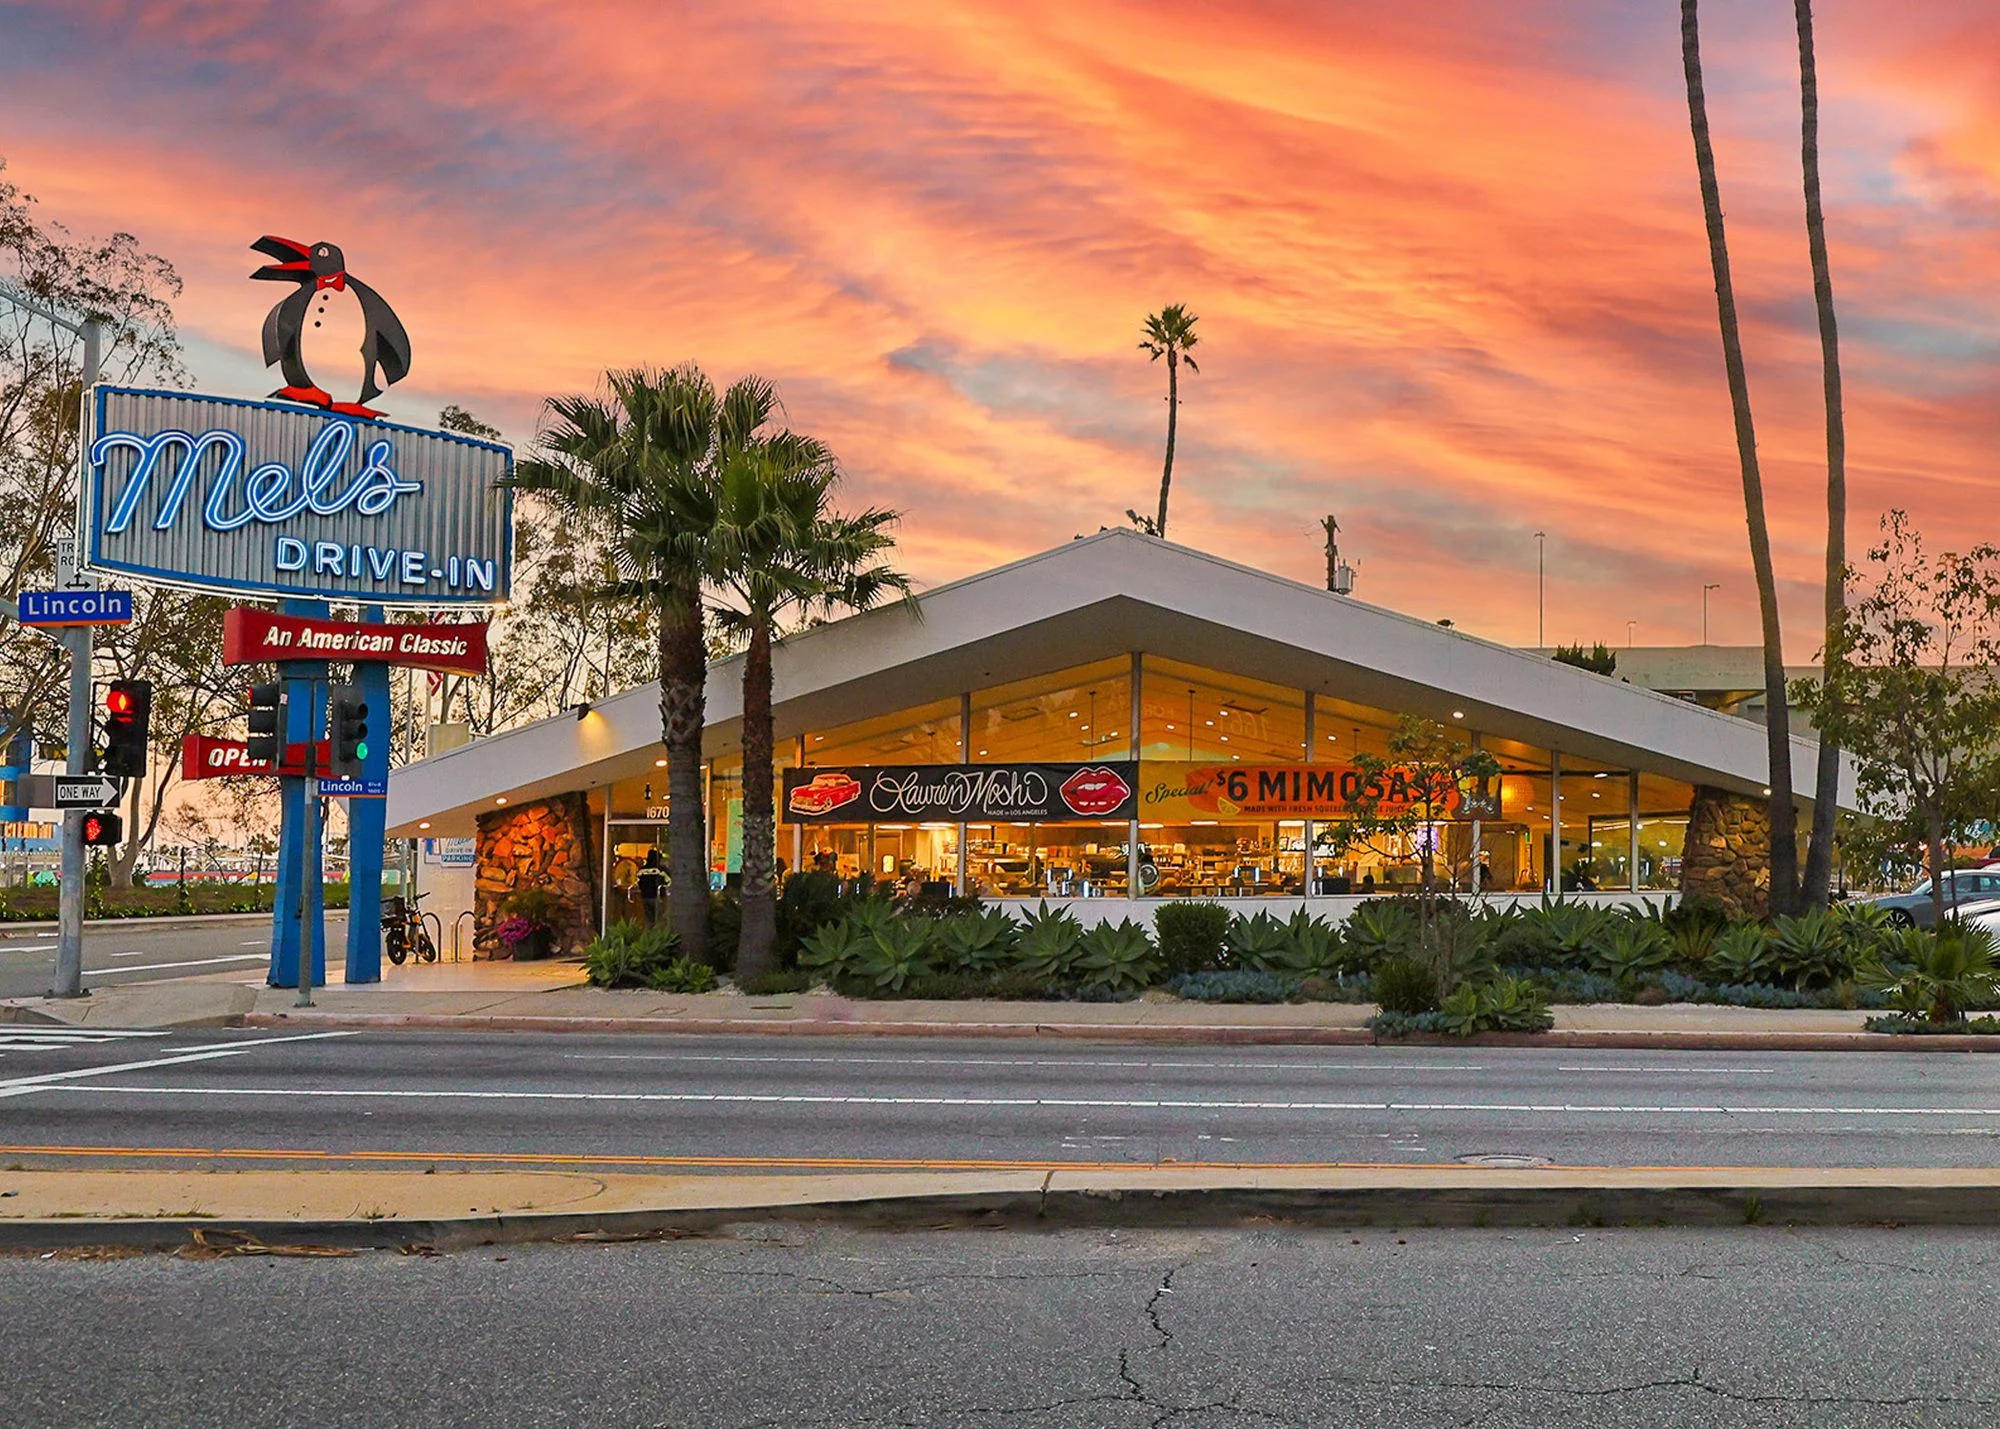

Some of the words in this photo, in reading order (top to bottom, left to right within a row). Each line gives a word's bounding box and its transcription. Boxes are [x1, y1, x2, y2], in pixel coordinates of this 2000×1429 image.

[89, 419, 425, 534] Mels
[277, 537, 494, 592] DRIVE-IN
[28, 593, 122, 615] Lincoln
[262, 625, 293, 647] An
[296, 626, 394, 652] American
[399, 632, 469, 655] Classic
[208, 748, 267, 767] OPE
[59, 786, 78, 799] ONE
[82, 786, 101, 799] WAY
[320, 780, 363, 792] Lincoln
[1145, 778, 1214, 804] Special!
[1216, 770, 1249, 802] $6
[646, 805, 670, 818] 1670
[1022, 808, 1048, 816] ANGELES
[1244, 805, 1266, 813] MADE
[1268, 805, 1287, 813] WITH
[1289, 805, 1313, 813] FRESH
[441, 854, 475, 863] PARKING
